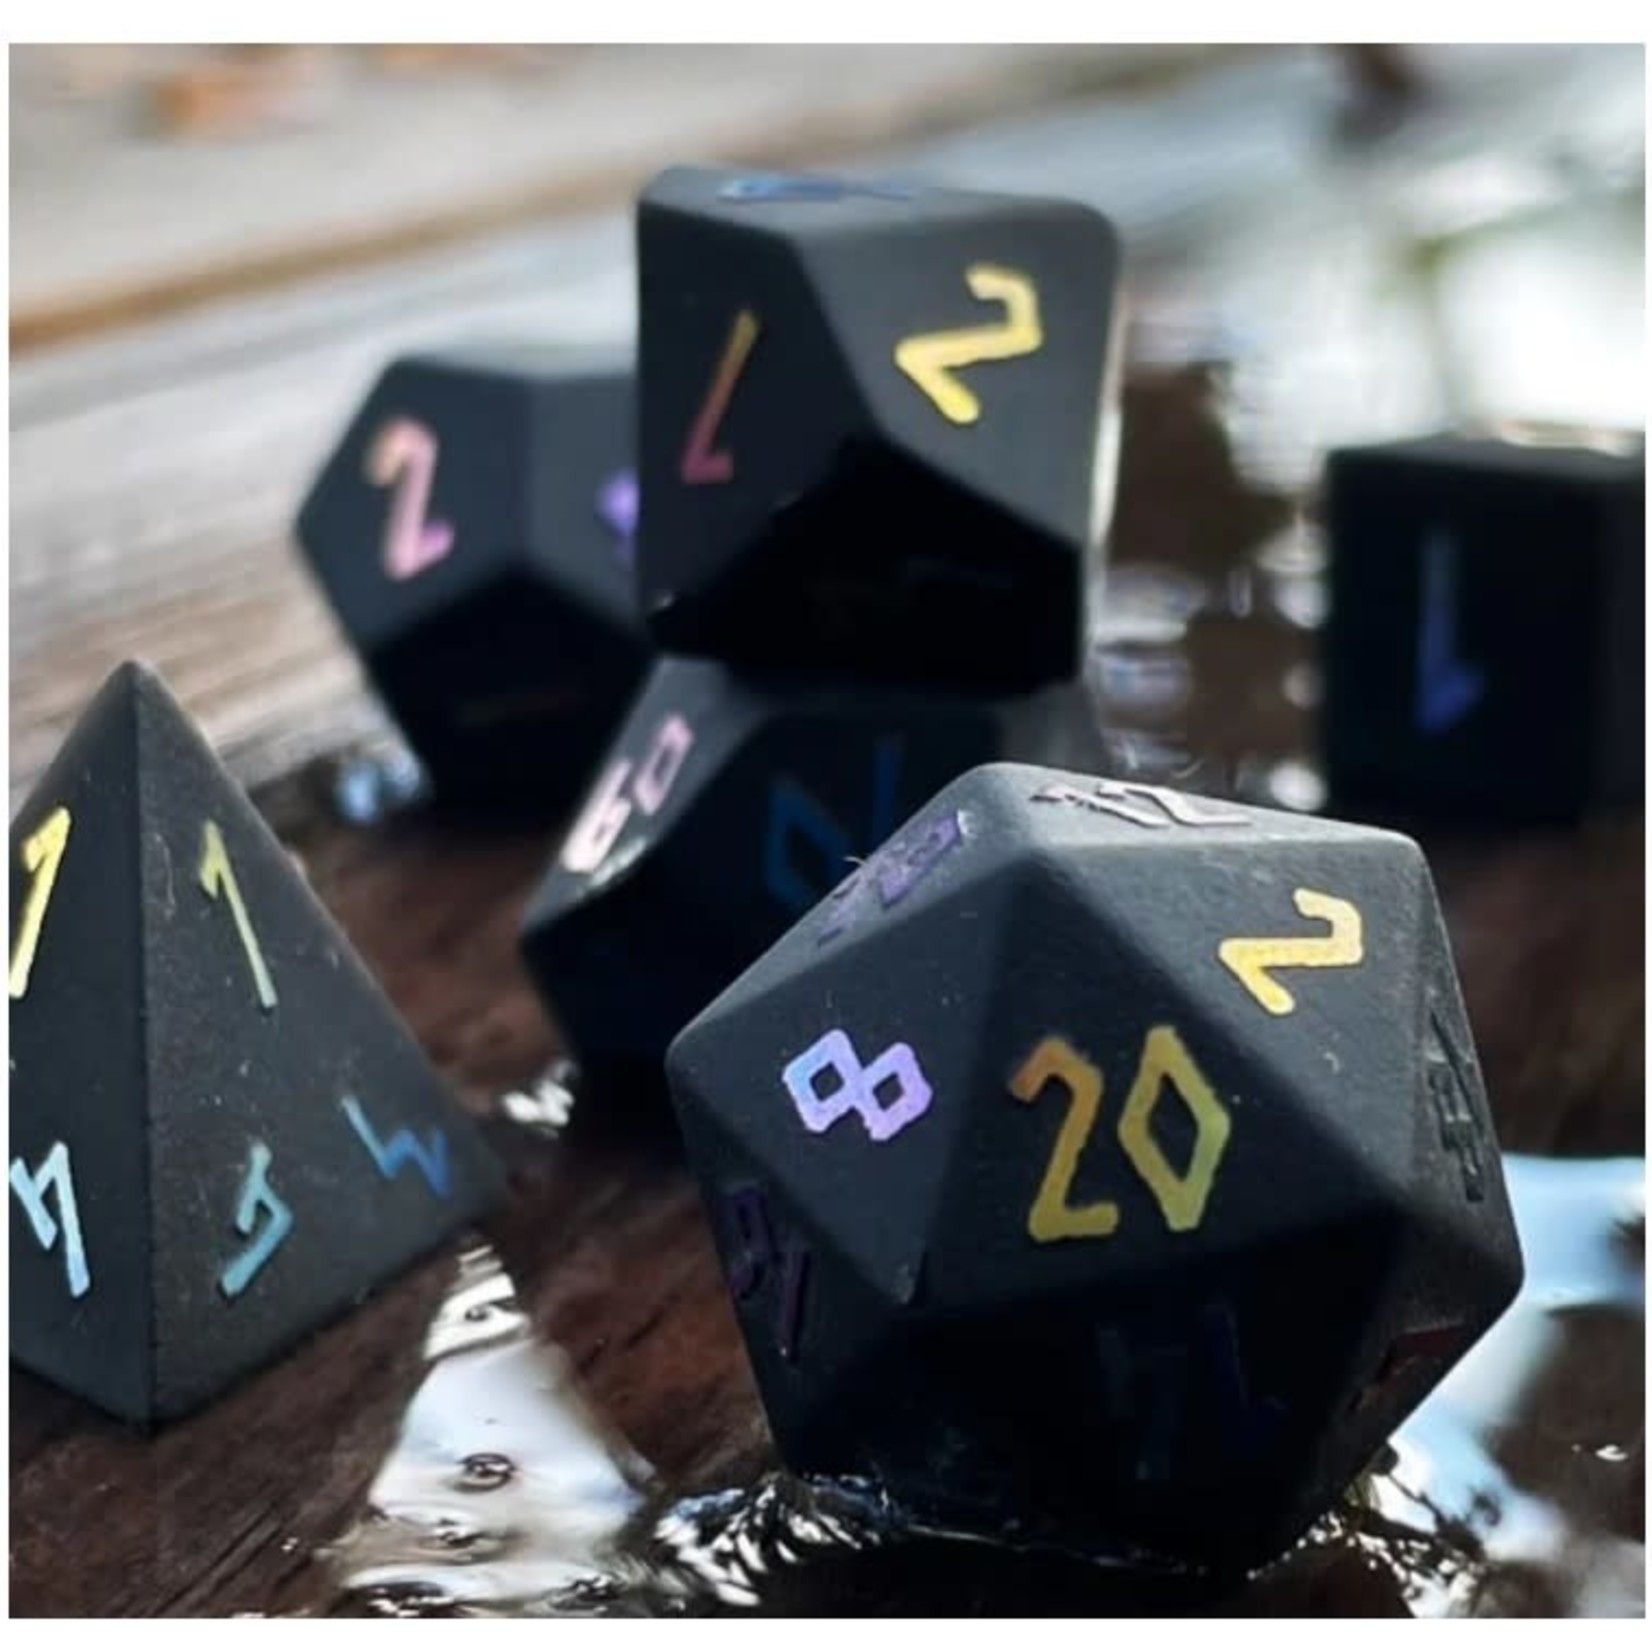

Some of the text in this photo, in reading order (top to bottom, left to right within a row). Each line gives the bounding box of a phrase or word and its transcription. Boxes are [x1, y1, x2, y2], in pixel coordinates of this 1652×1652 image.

[894, 262, 1043, 424] 2
[361, 414, 456, 582] 2
[9, 806, 71, 999] 1
[200, 820, 277, 1009] 1
[1218, 888, 1364, 1016] 2
[782, 1028, 933, 1142] 8
[1009, 1025, 1231, 1244] 20
